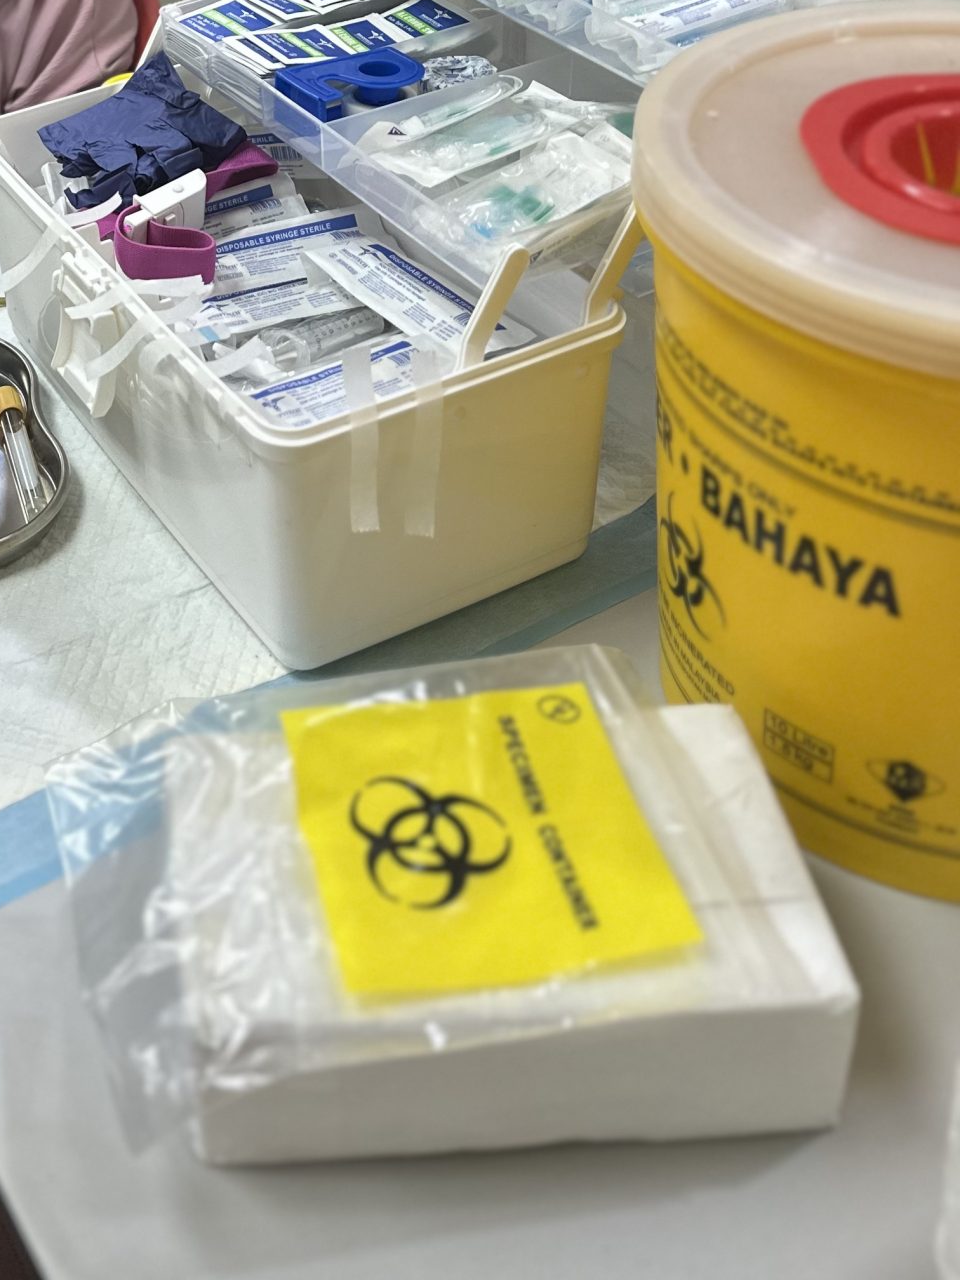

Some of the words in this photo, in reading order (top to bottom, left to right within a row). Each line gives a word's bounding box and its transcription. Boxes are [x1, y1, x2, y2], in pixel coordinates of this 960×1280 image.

[218, 194, 249, 210] STERILE
[216, 237, 265, 254] DISPOSABLE
[266, 229, 299, 244] SYRINGE
[300, 222, 331, 236] STERILE
[389, 254, 428, 282] DISPOSABLE
[700, 464, 903, 618] BAHAYA
[499, 714, 545, 816] SPECIMEN
[538, 825, 598, 932] CONTAINER
